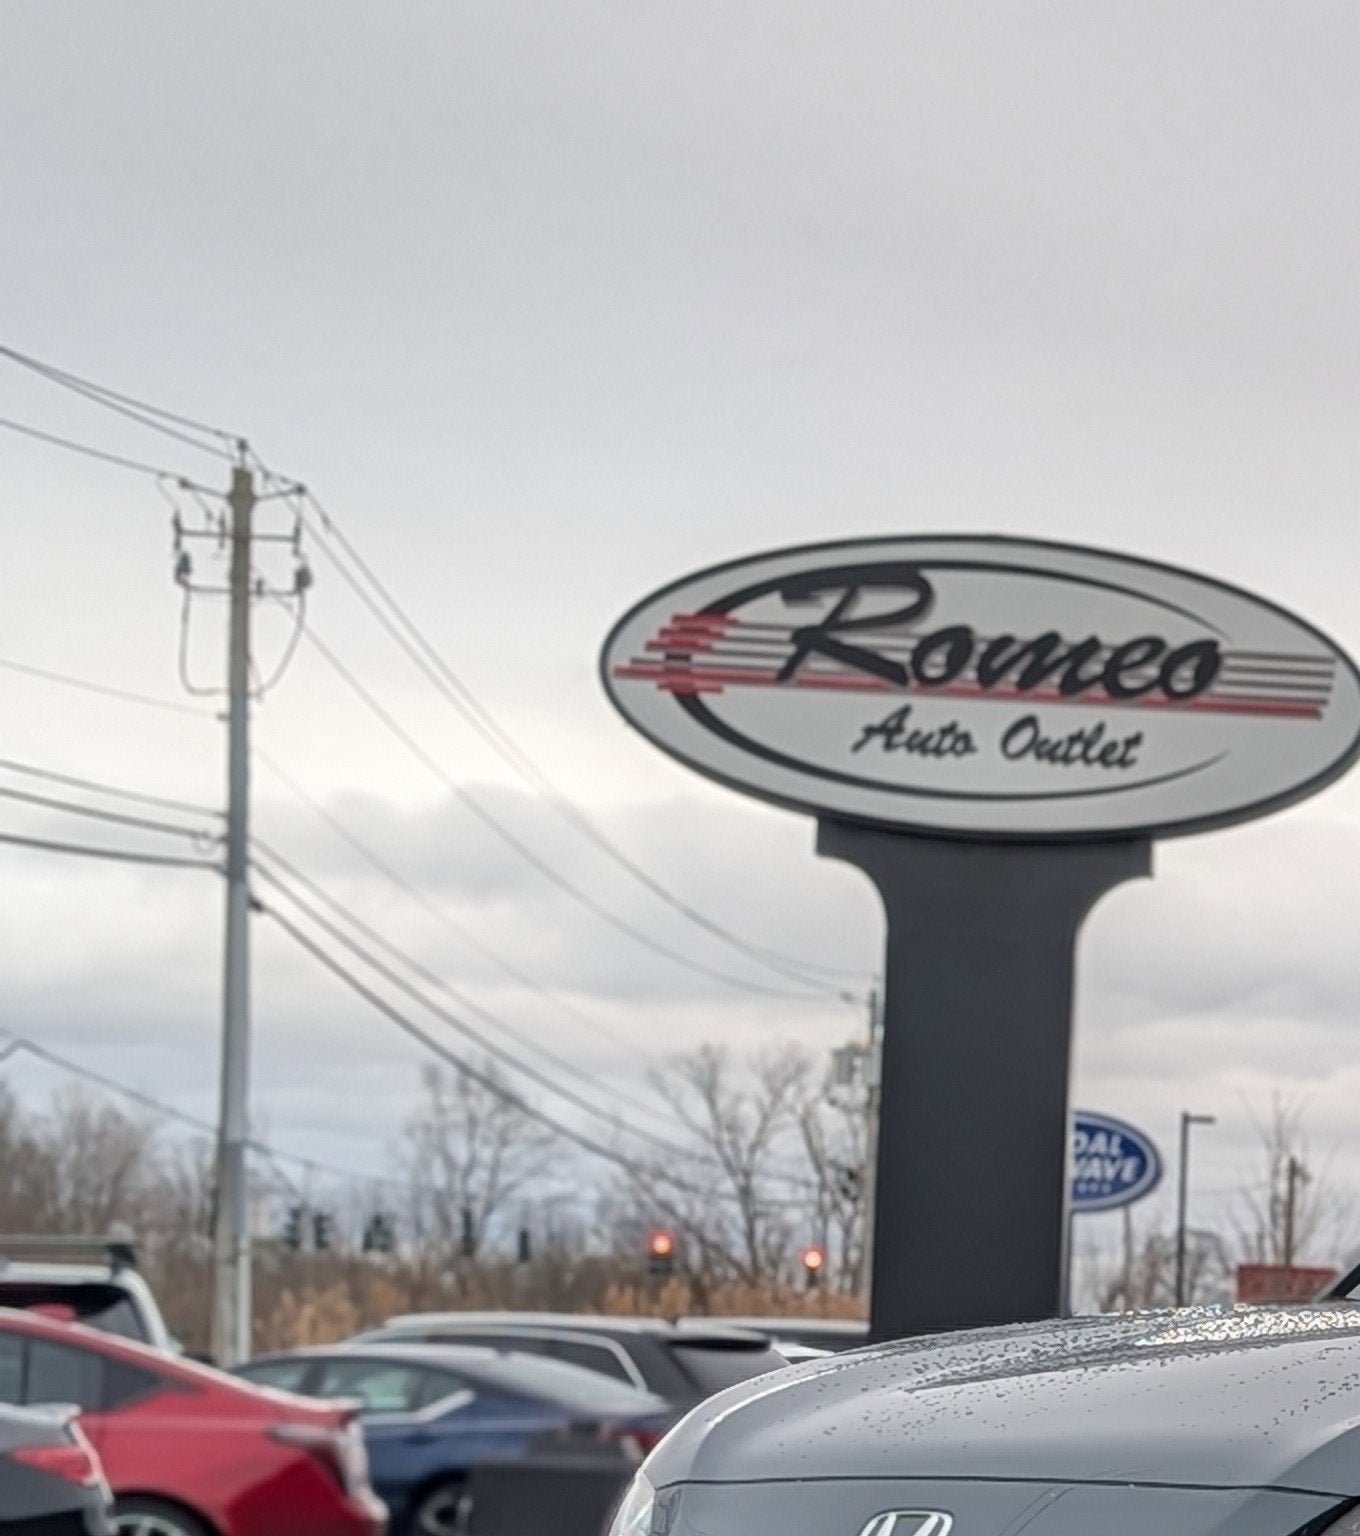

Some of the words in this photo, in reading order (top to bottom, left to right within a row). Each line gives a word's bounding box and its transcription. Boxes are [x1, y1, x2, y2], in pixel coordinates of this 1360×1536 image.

[777, 568, 1222, 700] Romeo
[850, 705, 977, 754] Auto
[1000, 717, 1144, 769] Outlet
